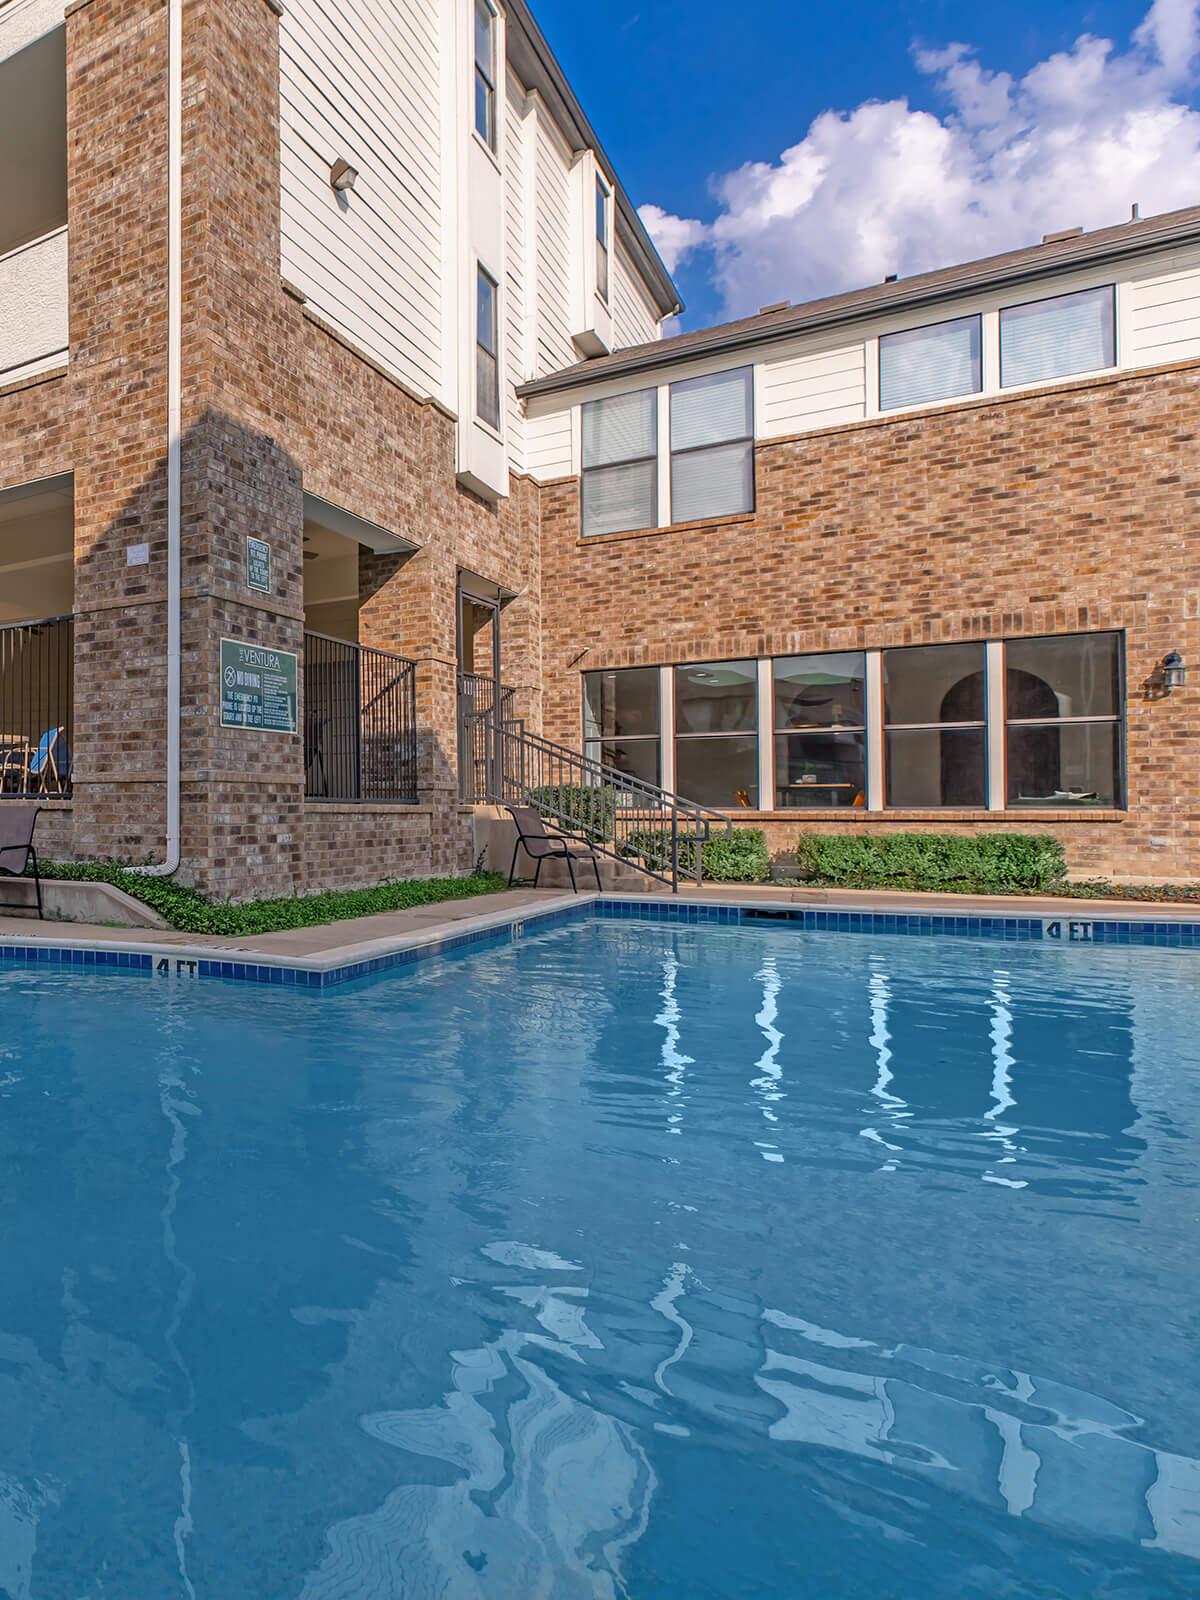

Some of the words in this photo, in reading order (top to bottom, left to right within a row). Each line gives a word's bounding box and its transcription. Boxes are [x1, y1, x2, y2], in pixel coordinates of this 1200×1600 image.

[244, 648, 281, 669] VENTURA
[237, 671, 244, 686] NO
[156, 958, 169, 971] 4
[177, 959, 197, 974] FT
